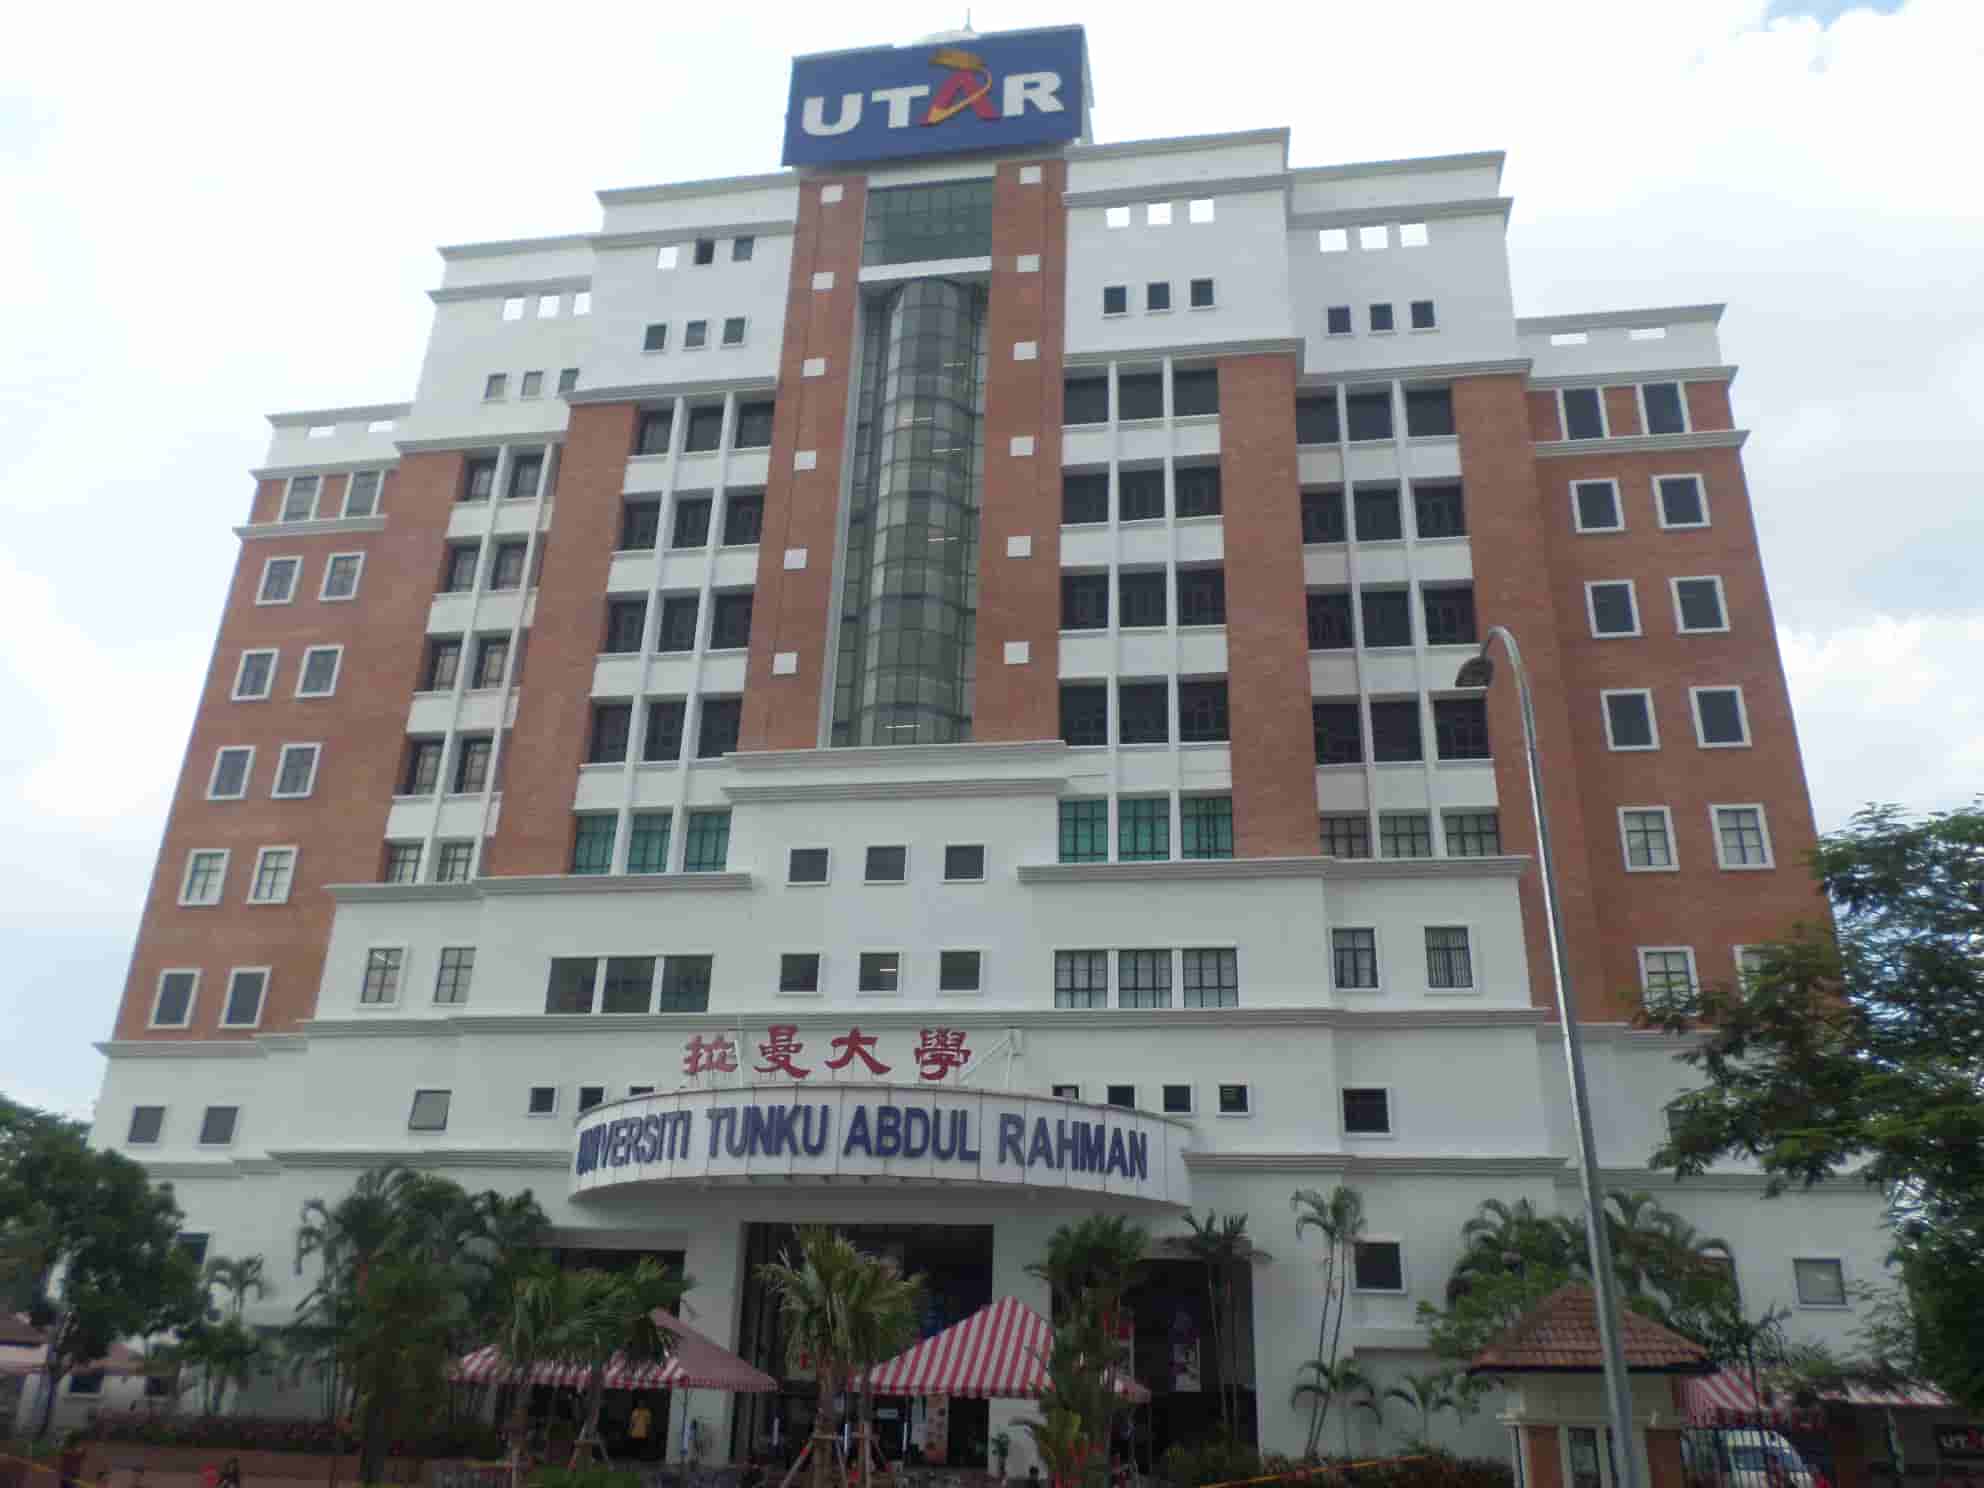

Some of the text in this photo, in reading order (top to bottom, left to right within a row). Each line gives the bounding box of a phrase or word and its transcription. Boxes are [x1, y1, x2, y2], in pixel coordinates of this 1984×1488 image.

[801, 70, 1064, 136] UTAR
[683, 1024, 971, 1080] 拉曼大學
[576, 1104, 1147, 1181] UNIVERSITI TUNKU ABDUL RAHMAN
